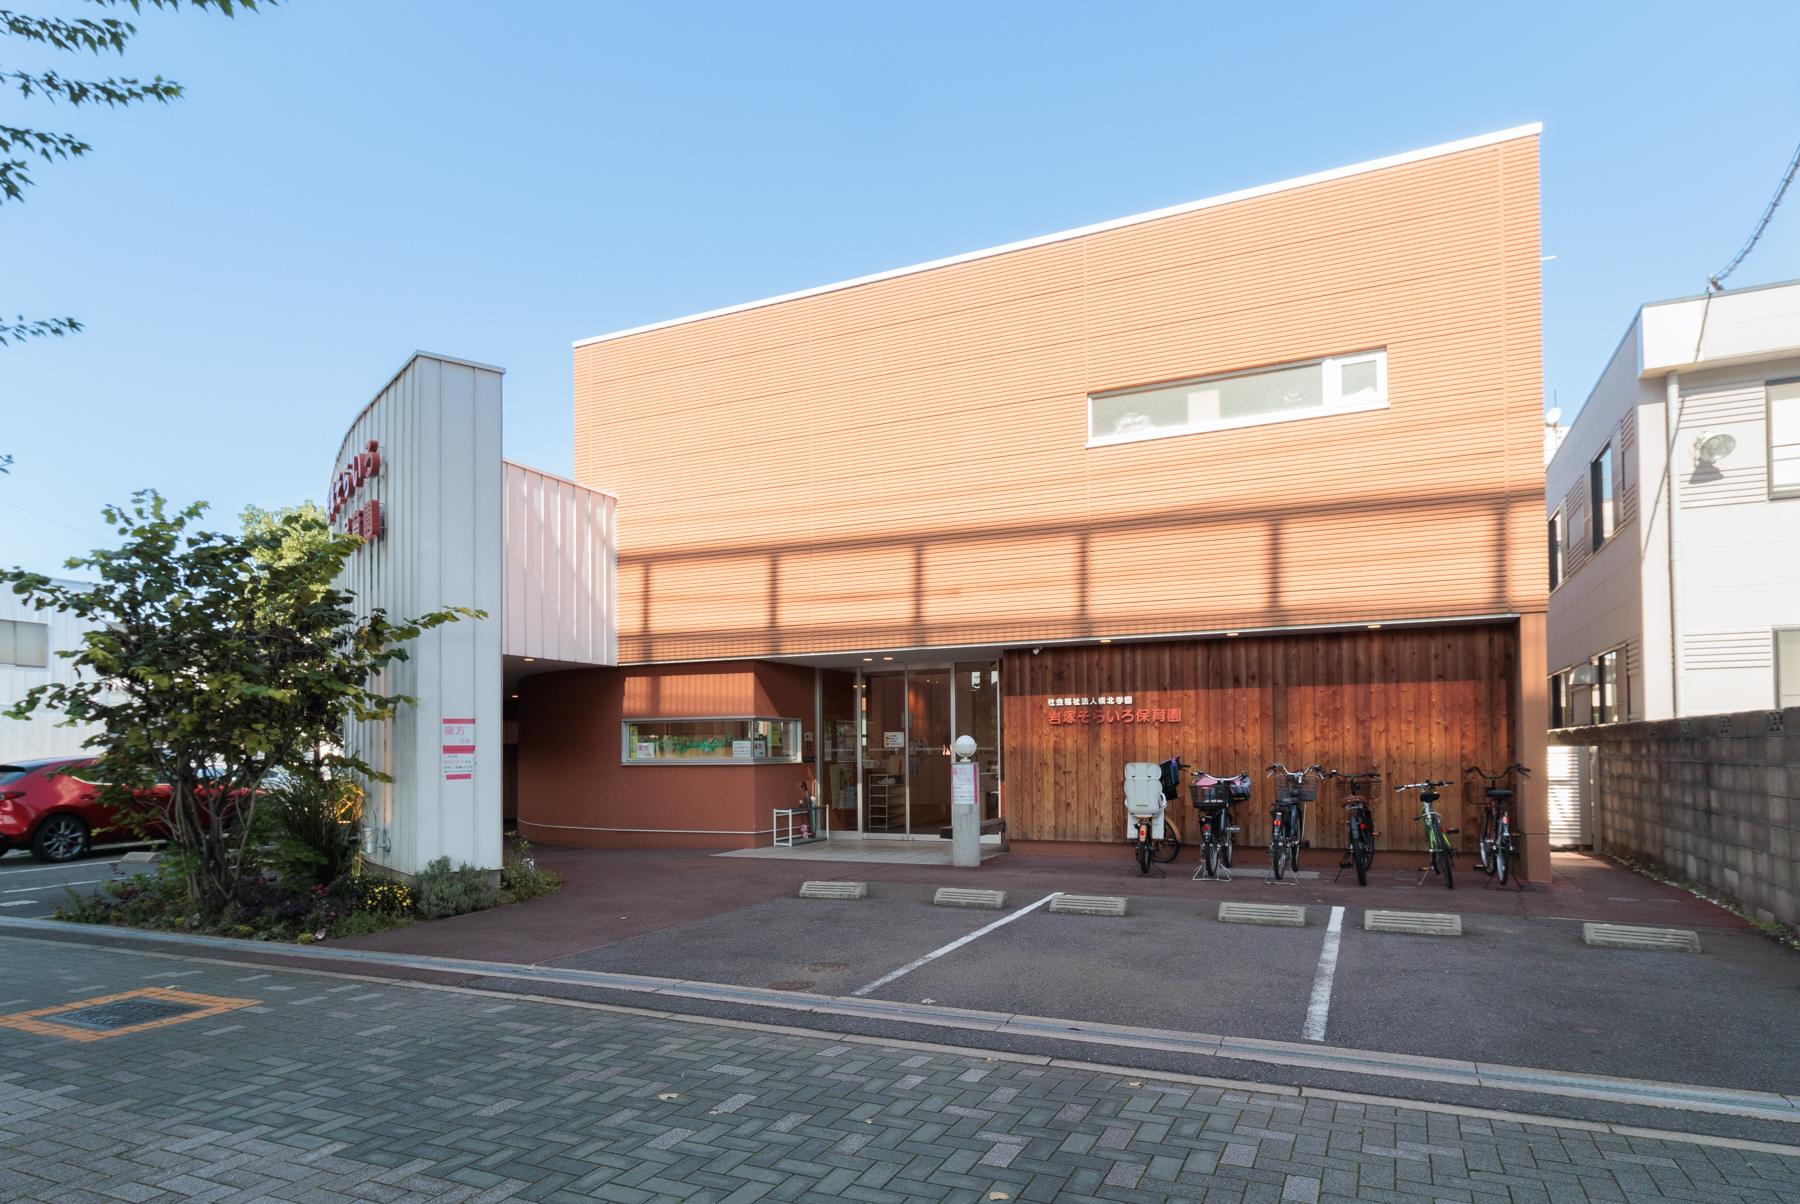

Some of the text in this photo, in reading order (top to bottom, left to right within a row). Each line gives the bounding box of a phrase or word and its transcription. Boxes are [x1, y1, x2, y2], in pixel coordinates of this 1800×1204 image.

[1048, 708, 1182, 725] 岩塚そらいろ保育園
[444, 725, 466, 736] 後方
